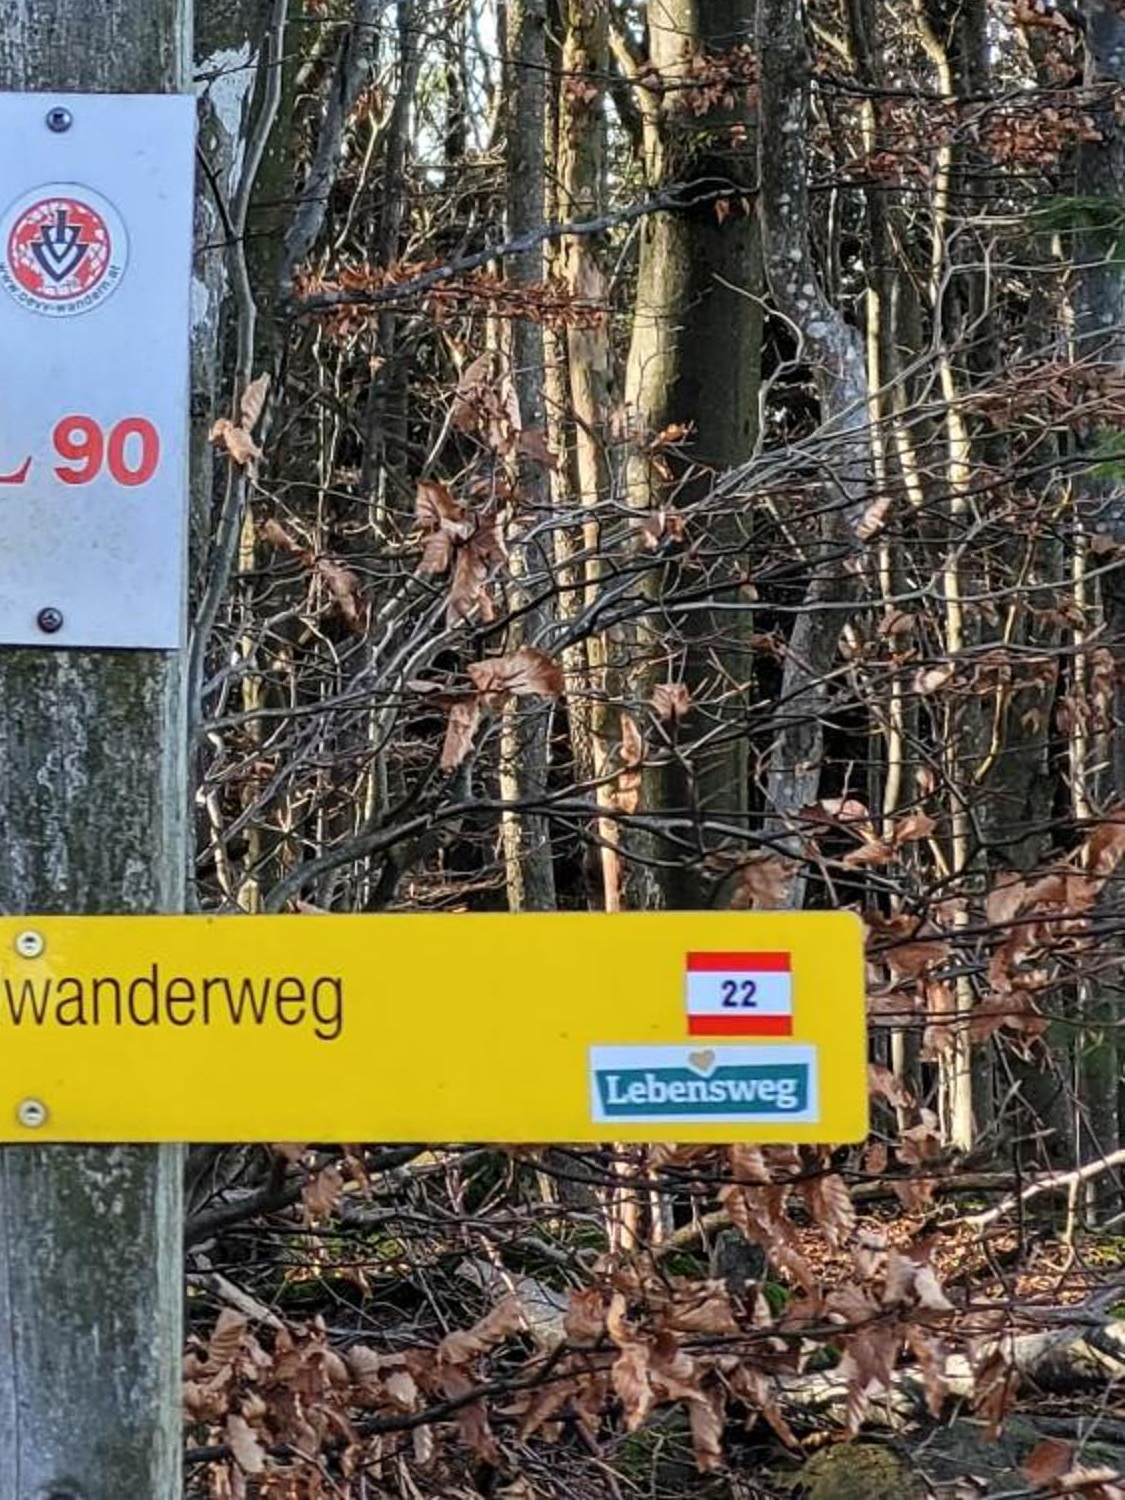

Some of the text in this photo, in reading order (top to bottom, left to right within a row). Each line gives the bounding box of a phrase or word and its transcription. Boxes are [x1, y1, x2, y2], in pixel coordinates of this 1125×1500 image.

[52, 415, 161, 487] 90
[720, 979, 758, 1008] 22
[606, 1072, 799, 1109] Lebensweg
